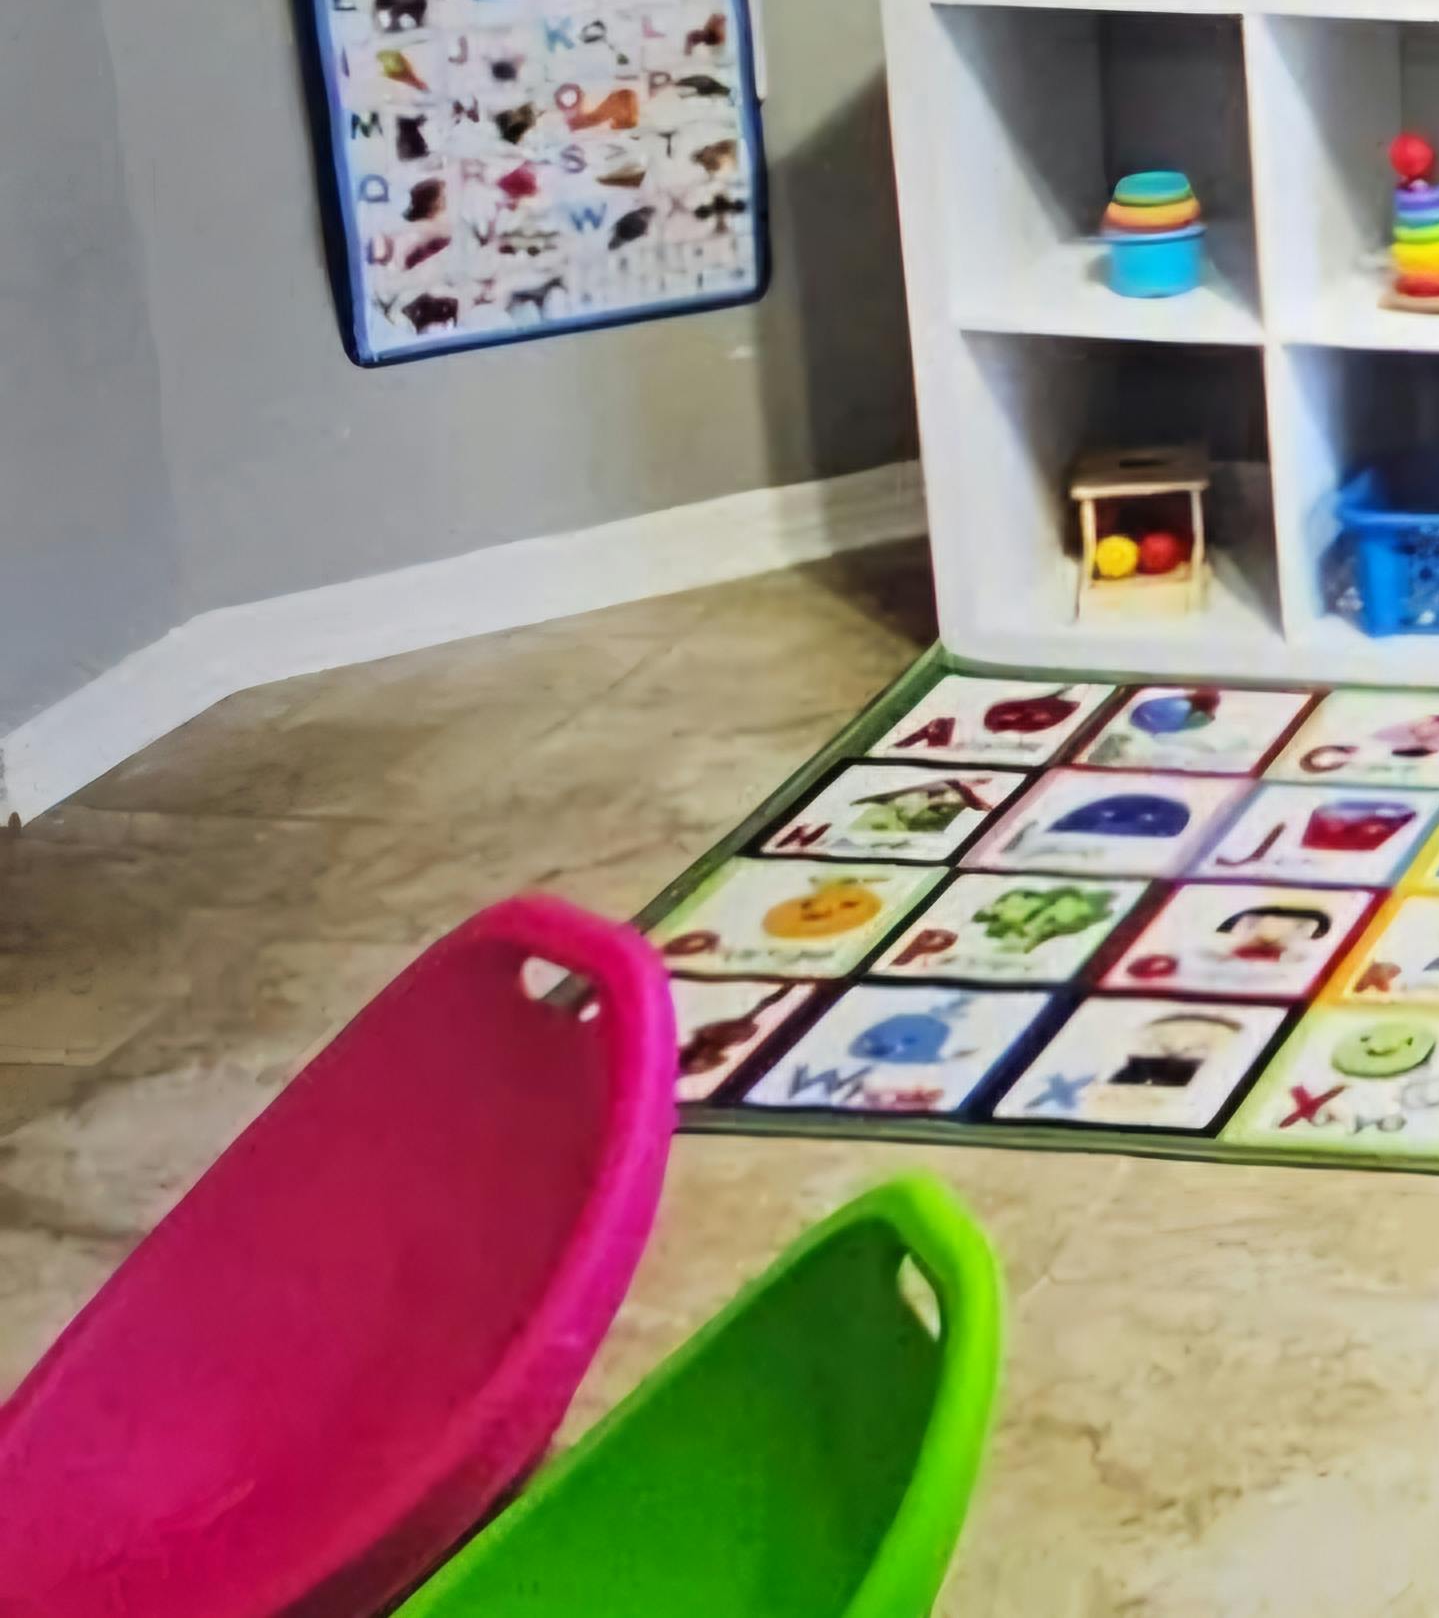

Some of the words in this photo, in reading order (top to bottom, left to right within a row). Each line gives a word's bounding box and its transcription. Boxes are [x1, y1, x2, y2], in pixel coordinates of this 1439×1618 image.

[447, 35, 469, 65] J
[543, 17, 575, 52] K
[350, 111, 384, 140] M
[647, 71, 673, 99] P
[559, 144, 588, 175] S
[656, 128, 680, 160] T
[569, 201, 608, 233] W
